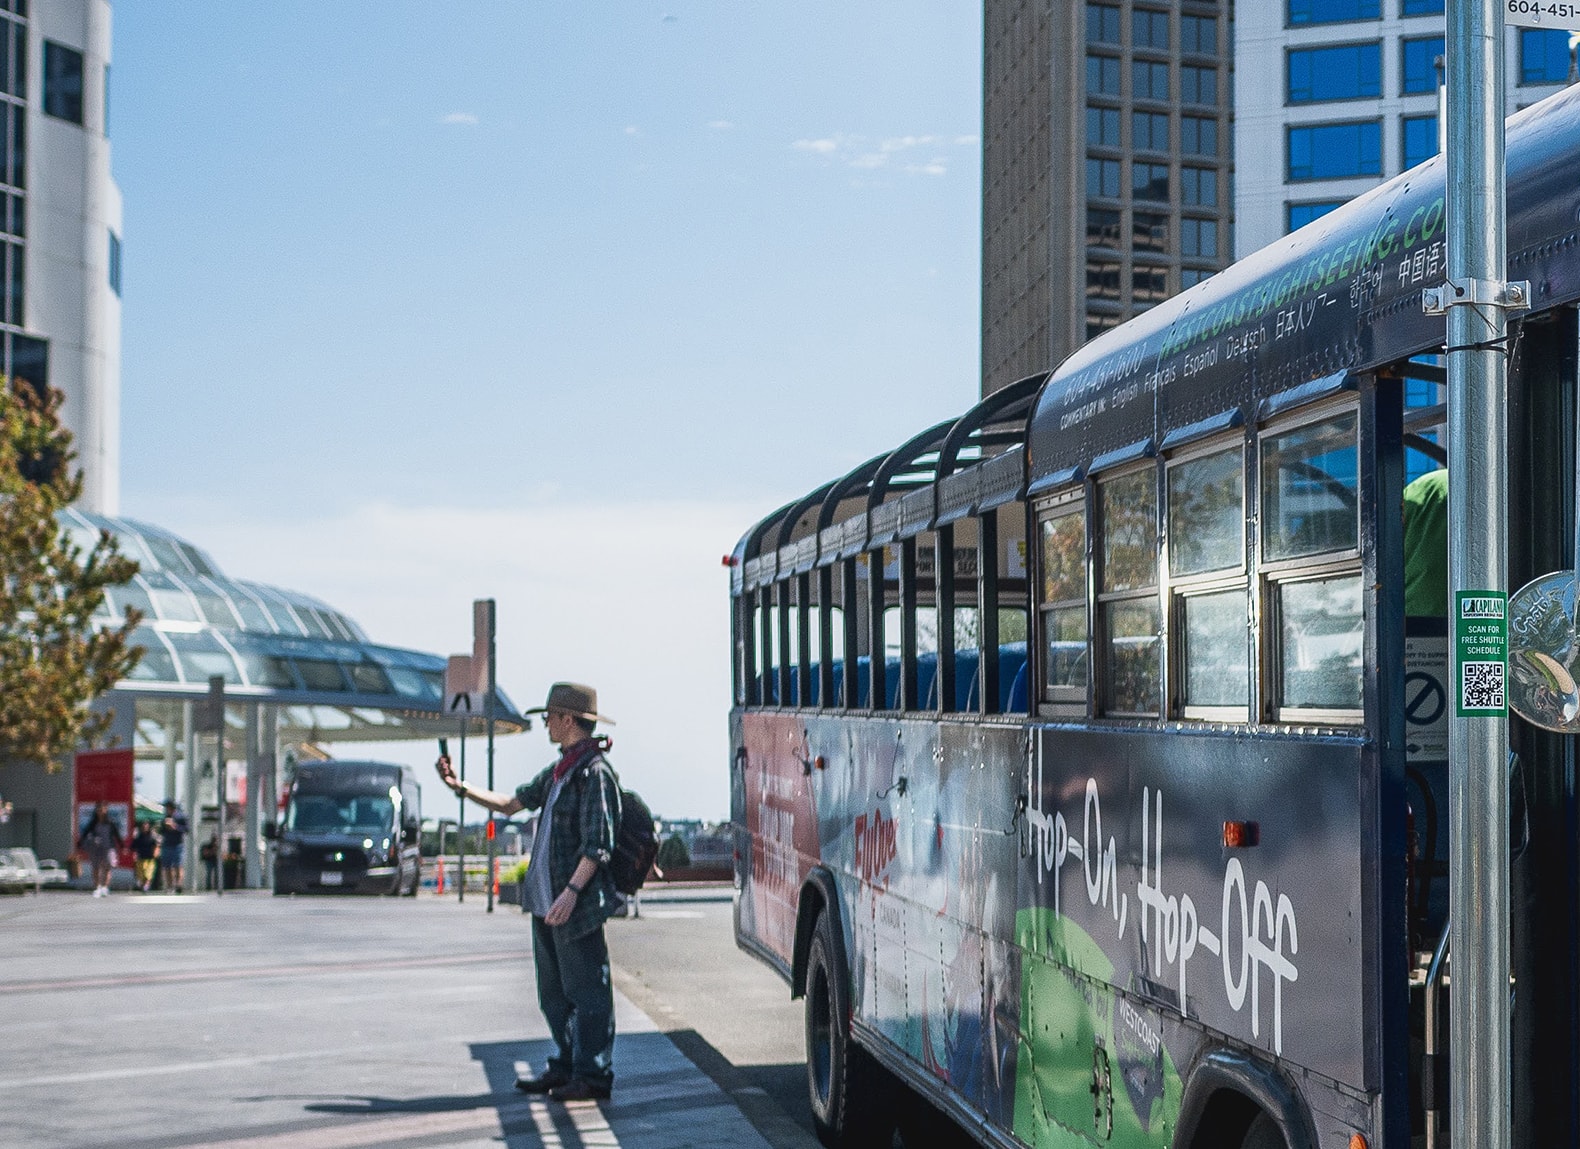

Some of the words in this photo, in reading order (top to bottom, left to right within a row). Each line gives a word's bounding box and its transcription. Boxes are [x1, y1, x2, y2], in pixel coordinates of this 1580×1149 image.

[1160, 197, 1446, 360] WESTCOASTSIGHTSEEING.CO
[1183, 342, 1219, 378] Español
[1226, 322, 1266, 360] Deutsch
[1461, 636, 1478, 644] FREE
[1478, 636, 1504, 645] SHUTTLE
[1468, 625, 1487, 634] SCAN
[1488, 625, 1500, 634] FOR
[1467, 646, 1501, 655] SCHEDULE
[1026, 727, 1128, 940] Hop-On,
[1137, 786, 1298, 1057] Hop-Off
